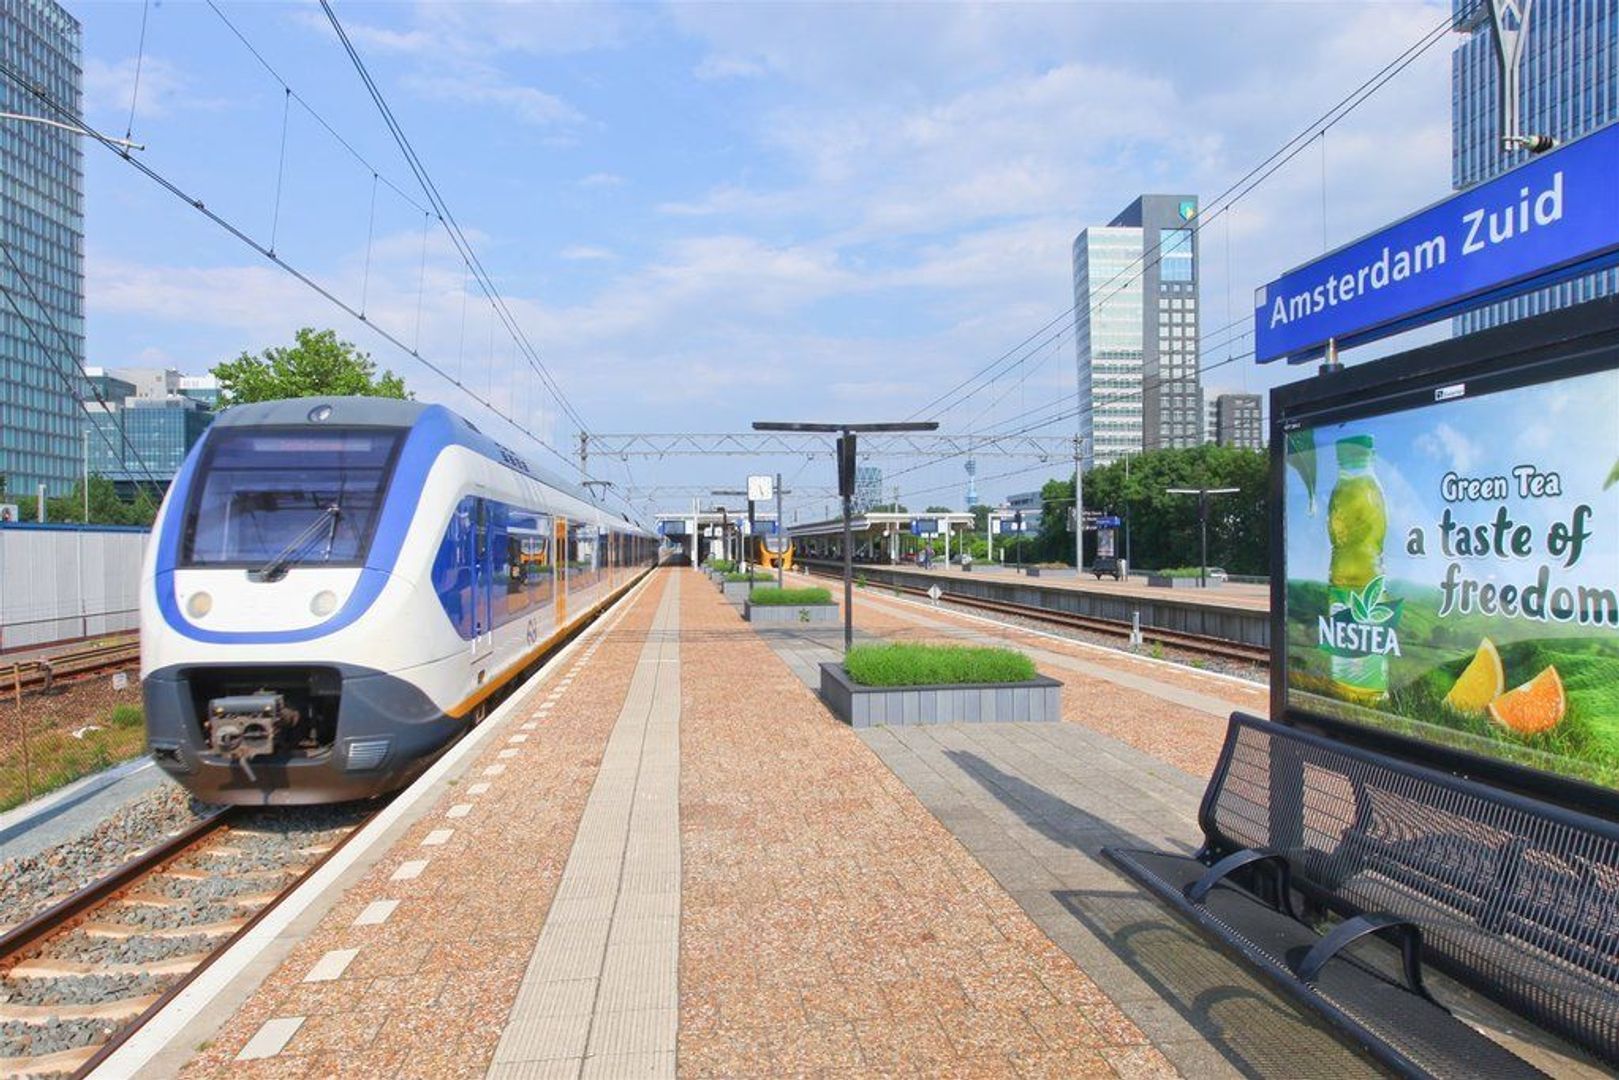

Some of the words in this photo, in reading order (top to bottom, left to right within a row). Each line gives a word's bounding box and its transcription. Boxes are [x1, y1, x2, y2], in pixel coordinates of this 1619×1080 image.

[1270, 236, 1445, 328] Amsterdam
[1462, 171, 1564, 255] Zuid
[1441, 472, 1508, 502] Green
[1512, 465, 1562, 498] Tea
[1407, 527, 1426, 556] a
[1438, 506, 1533, 558] taste
[1547, 504, 1592, 568] of
[1438, 562, 1619, 626] freedom
[1318, 615, 1401, 656] NESTEA
